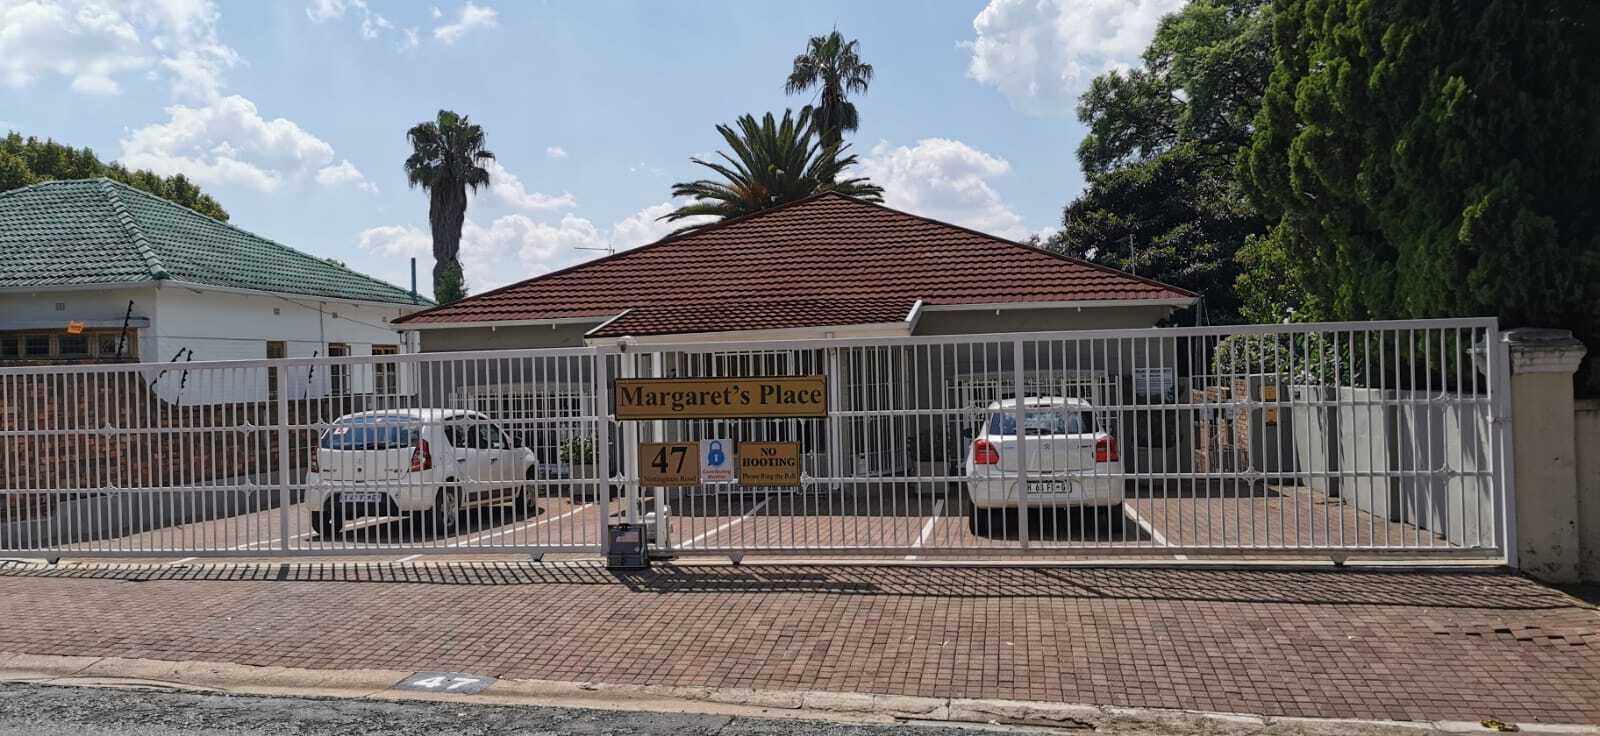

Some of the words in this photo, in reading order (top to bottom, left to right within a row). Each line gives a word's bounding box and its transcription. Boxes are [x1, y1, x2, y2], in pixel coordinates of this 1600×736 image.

[620, 385, 750, 411] Margaret's
[759, 384, 821, 405] Place
[761, 447, 777, 456] NO
[651, 446, 687, 473] 47
[743, 458, 795, 467] HOOTING
[413, 676, 480, 689] 47
